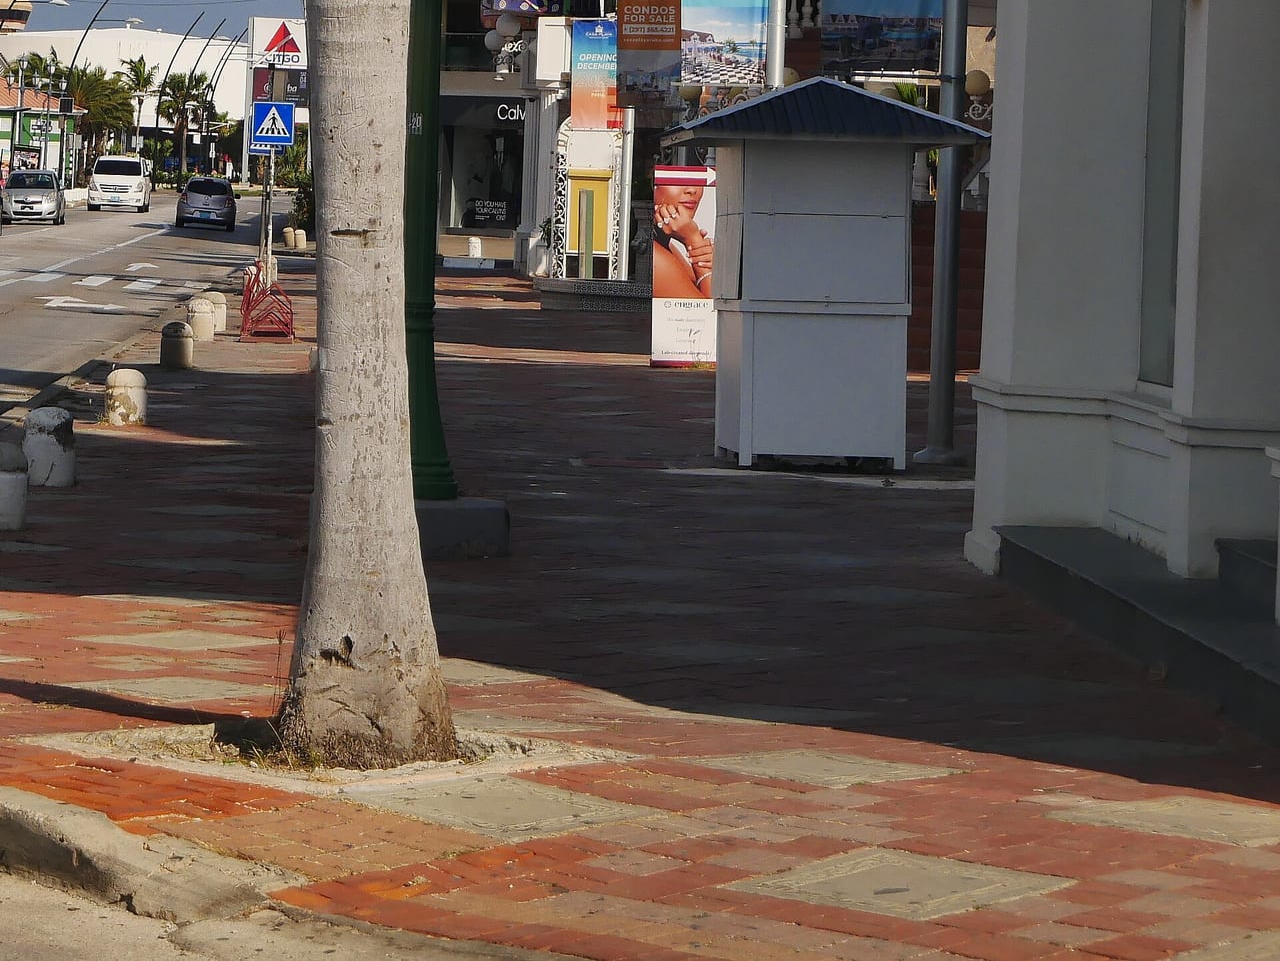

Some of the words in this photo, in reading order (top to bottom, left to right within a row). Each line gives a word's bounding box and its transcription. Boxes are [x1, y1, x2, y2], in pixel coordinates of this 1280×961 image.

[624, 5, 676, 15] CONDOS
[624, 15, 645, 23] FOR
[648, 15, 676, 23] SALE
[265, 53, 300, 64] CITGO
[577, 62, 617, 70] DECEMBE
